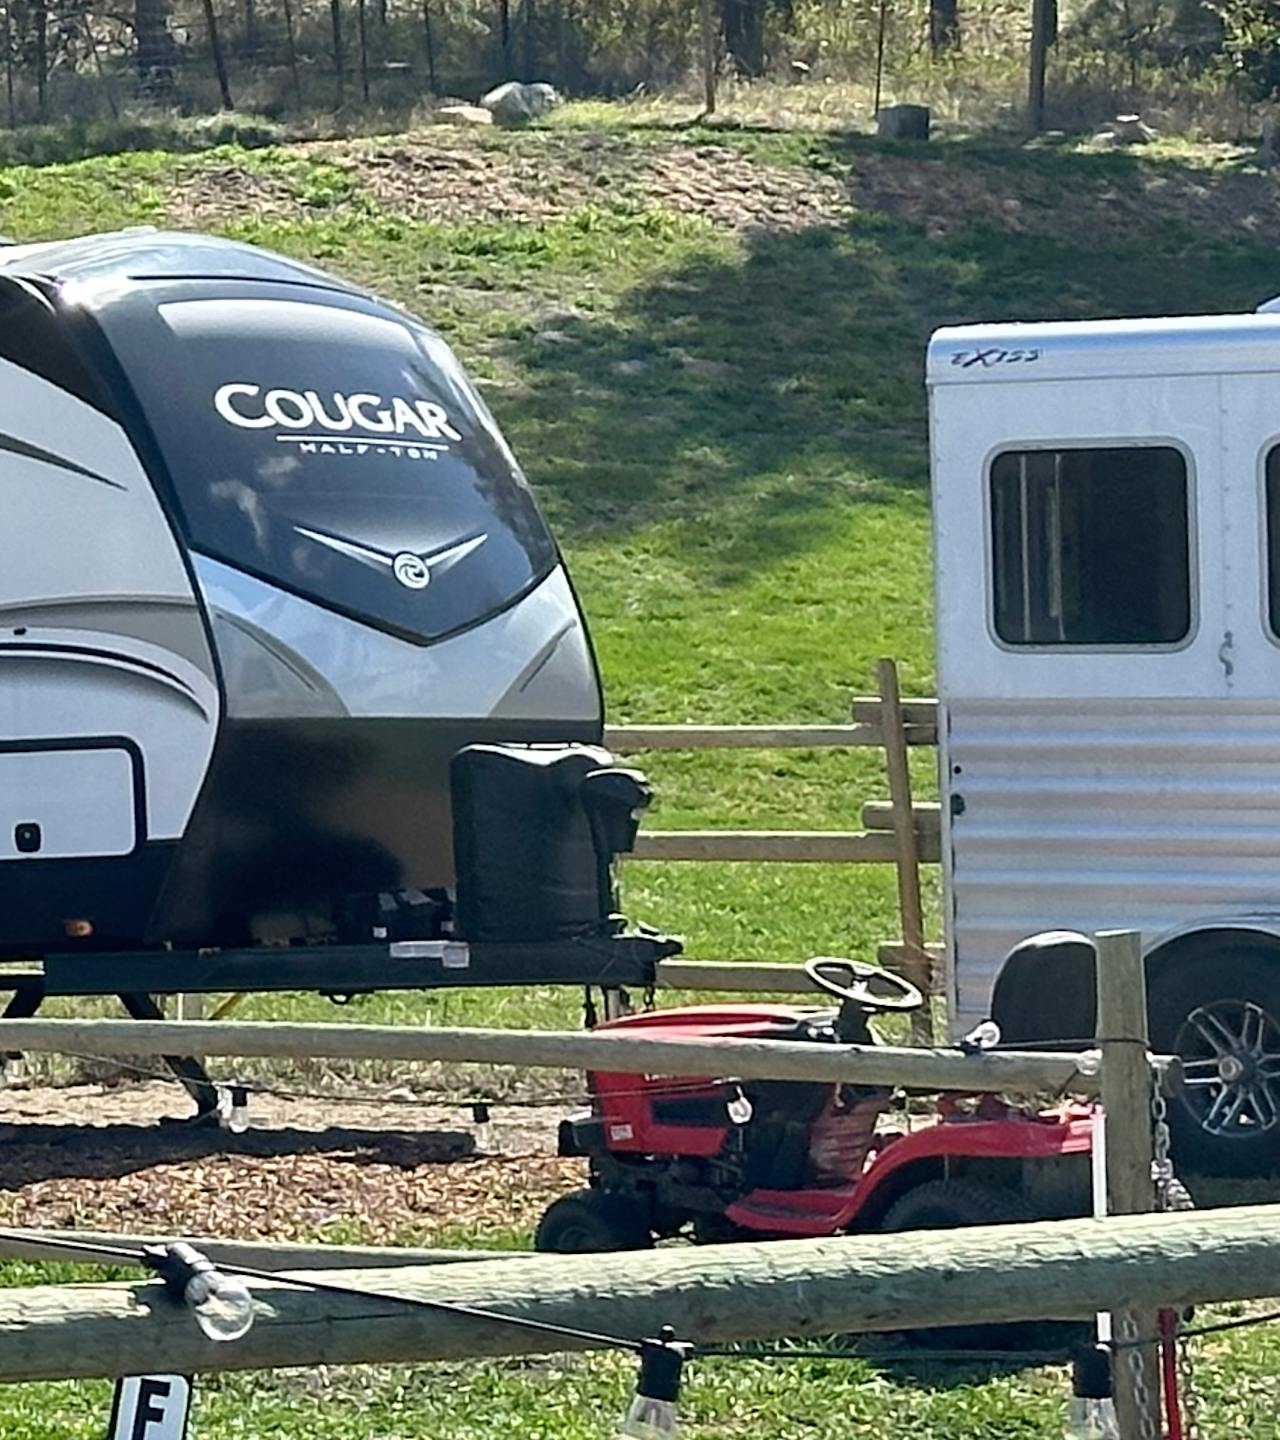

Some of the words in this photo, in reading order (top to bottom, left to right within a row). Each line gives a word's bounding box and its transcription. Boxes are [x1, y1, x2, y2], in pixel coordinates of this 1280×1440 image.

[214, 383, 463, 442] COUGAR
[299, 442, 438, 460] HALF-TON
[132, 1378, 172, 1440] F
